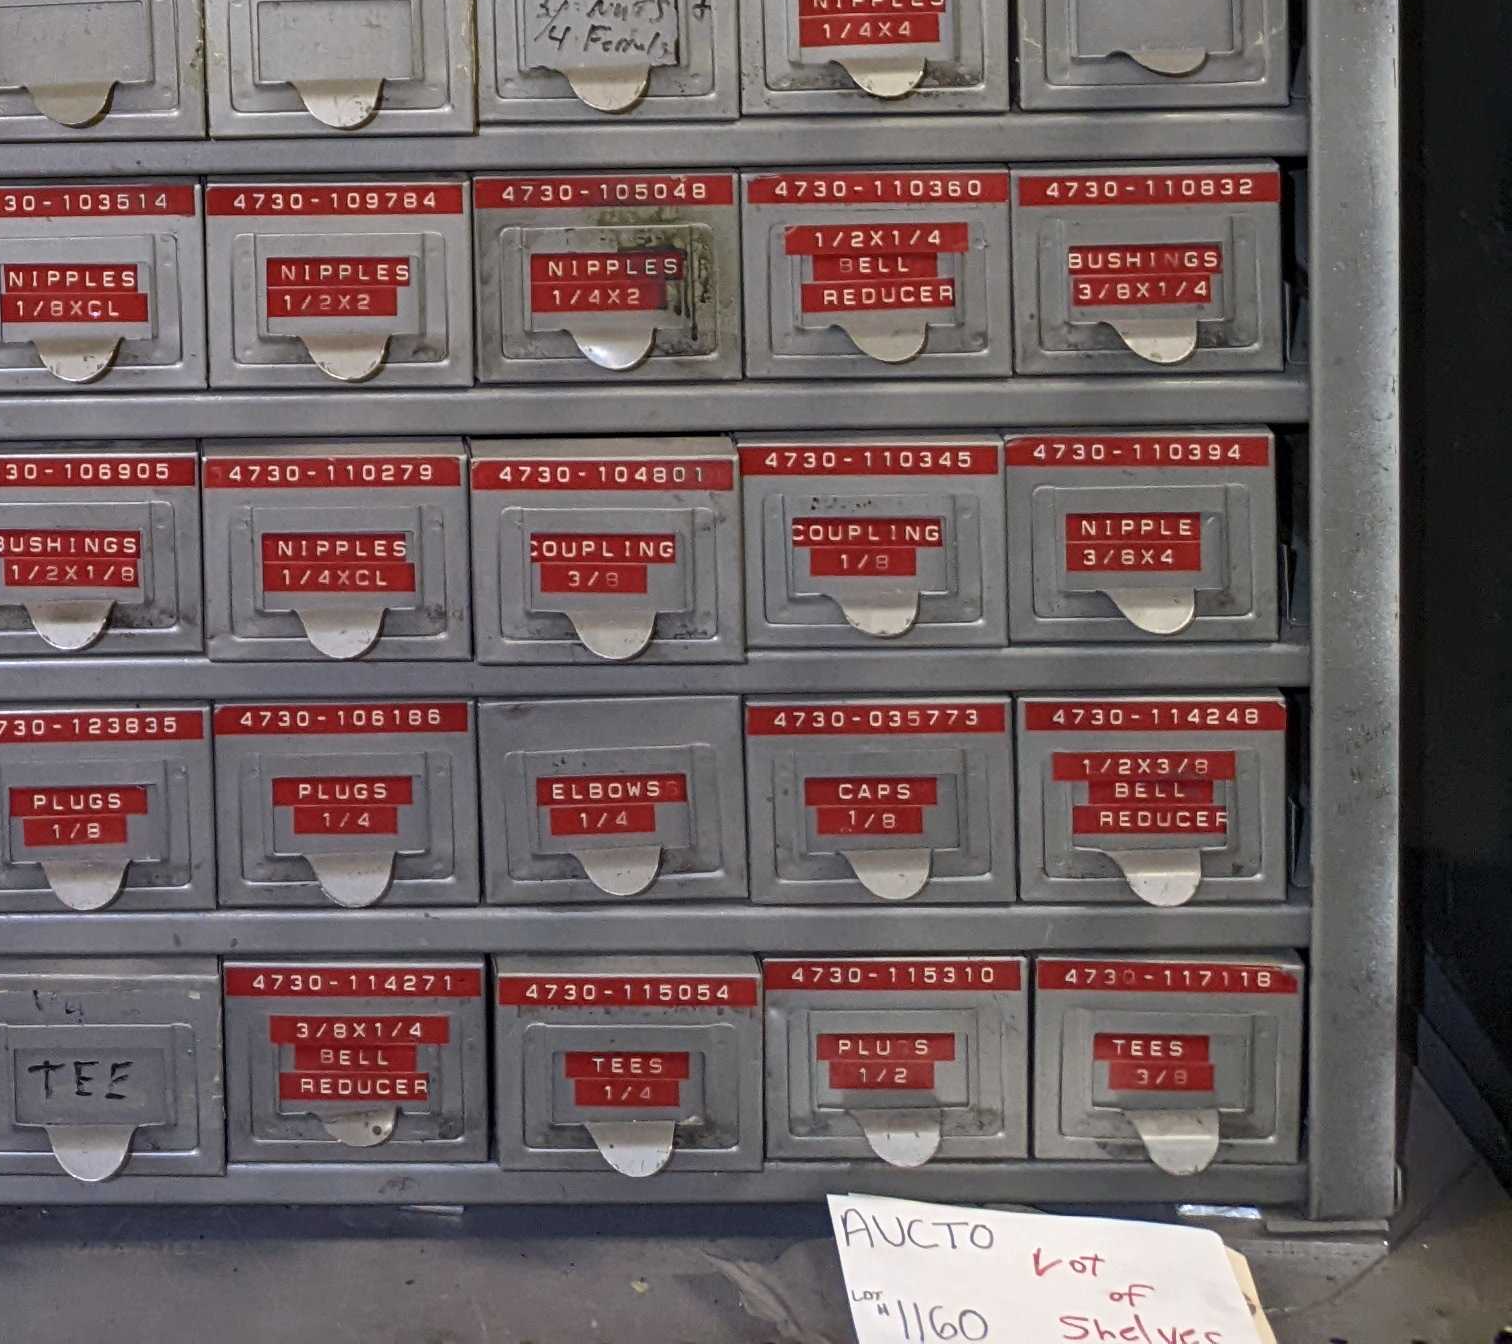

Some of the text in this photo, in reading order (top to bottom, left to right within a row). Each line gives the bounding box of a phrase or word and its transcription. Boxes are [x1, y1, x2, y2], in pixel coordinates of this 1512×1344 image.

[823, 22, 911, 39] 1/4X4
[502, 183, 706, 200] 4730-105048
[774, 179, 981, 196] 4730-110360
[1046, 178, 1252, 196] 4730-110832
[234, 192, 436, 211] 4730-109784
[815, 230, 940, 248] 1/2X1/4
[549, 259, 678, 276] NIPPLES
[839, 257, 909, 273] BELL
[1069, 251, 1219, 269] BUSHINGS
[9, 271, 136, 287] NIPPLES
[281, 265, 410, 281] NIPPLES
[553, 288, 640, 305] 1/4X2
[824, 286, 953, 305] REDUCER
[1078, 281, 1207, 300] 3/8X1/4
[17, 300, 118, 316] 1/8XCL
[284, 294, 371, 310] 1/2X2
[765, 451, 972, 469] 4730-110345
[1033, 444, 1241, 461] 4730-110394
[229, 464, 433, 482] 4730-110279
[499, 466, 703, 483] 4730-104801
[793, 524, 940, 542] COUPLING
[1081, 520, 1193, 536] NIPPLE
[278, 540, 406, 556] NIPPLES
[531, 540, 674, 558] COUPLING
[840, 554, 888, 570] 1/8
[12, 565, 135, 582] 1/2X1/8
[283, 570, 388, 586] 1/4XCL
[568, 572, 618, 587] 3/8
[241, 709, 440, 727] 4730-106186
[775, 710, 978, 728] 4730-035773
[1052, 708, 1259, 726] 4730-114248
[1082, 759, 1208, 774] 1/2X3/8
[299, 783, 388, 800] PLUGS
[552, 781, 659, 800] ELBOWS
[839, 784, 910, 800] CAPS
[1116, 784, 1185, 799] BELL
[33, 794, 121, 810] PLUGS
[323, 812, 369, 827] 1/4
[581, 812, 628, 827] 1/4
[849, 811, 897, 830] 1/8
[52, 823, 101, 839] 1/8
[253, 974, 453, 992] 4730-114271
[792, 966, 994, 984] 4730-115310
[525, 984, 729, 1001] 4730-115054
[296, 1022, 422, 1039] 3/8X1/4
[839, 1039, 929, 1057] PLUS
[1113, 1039, 1183, 1057] TEES
[320, 1050, 388, 1066] BELL
[592, 1057, 663, 1074] TEES
[28, 1059, 134, 1100] TEE
[858, 1067, 907, 1083] 1/2
[1136, 1068, 1188, 1085] 3/8
[301, 1078, 427, 1095] REDUCER
[603, 1085, 652, 1101] 1/4
[840, 1207, 994, 1250] AUCTO
